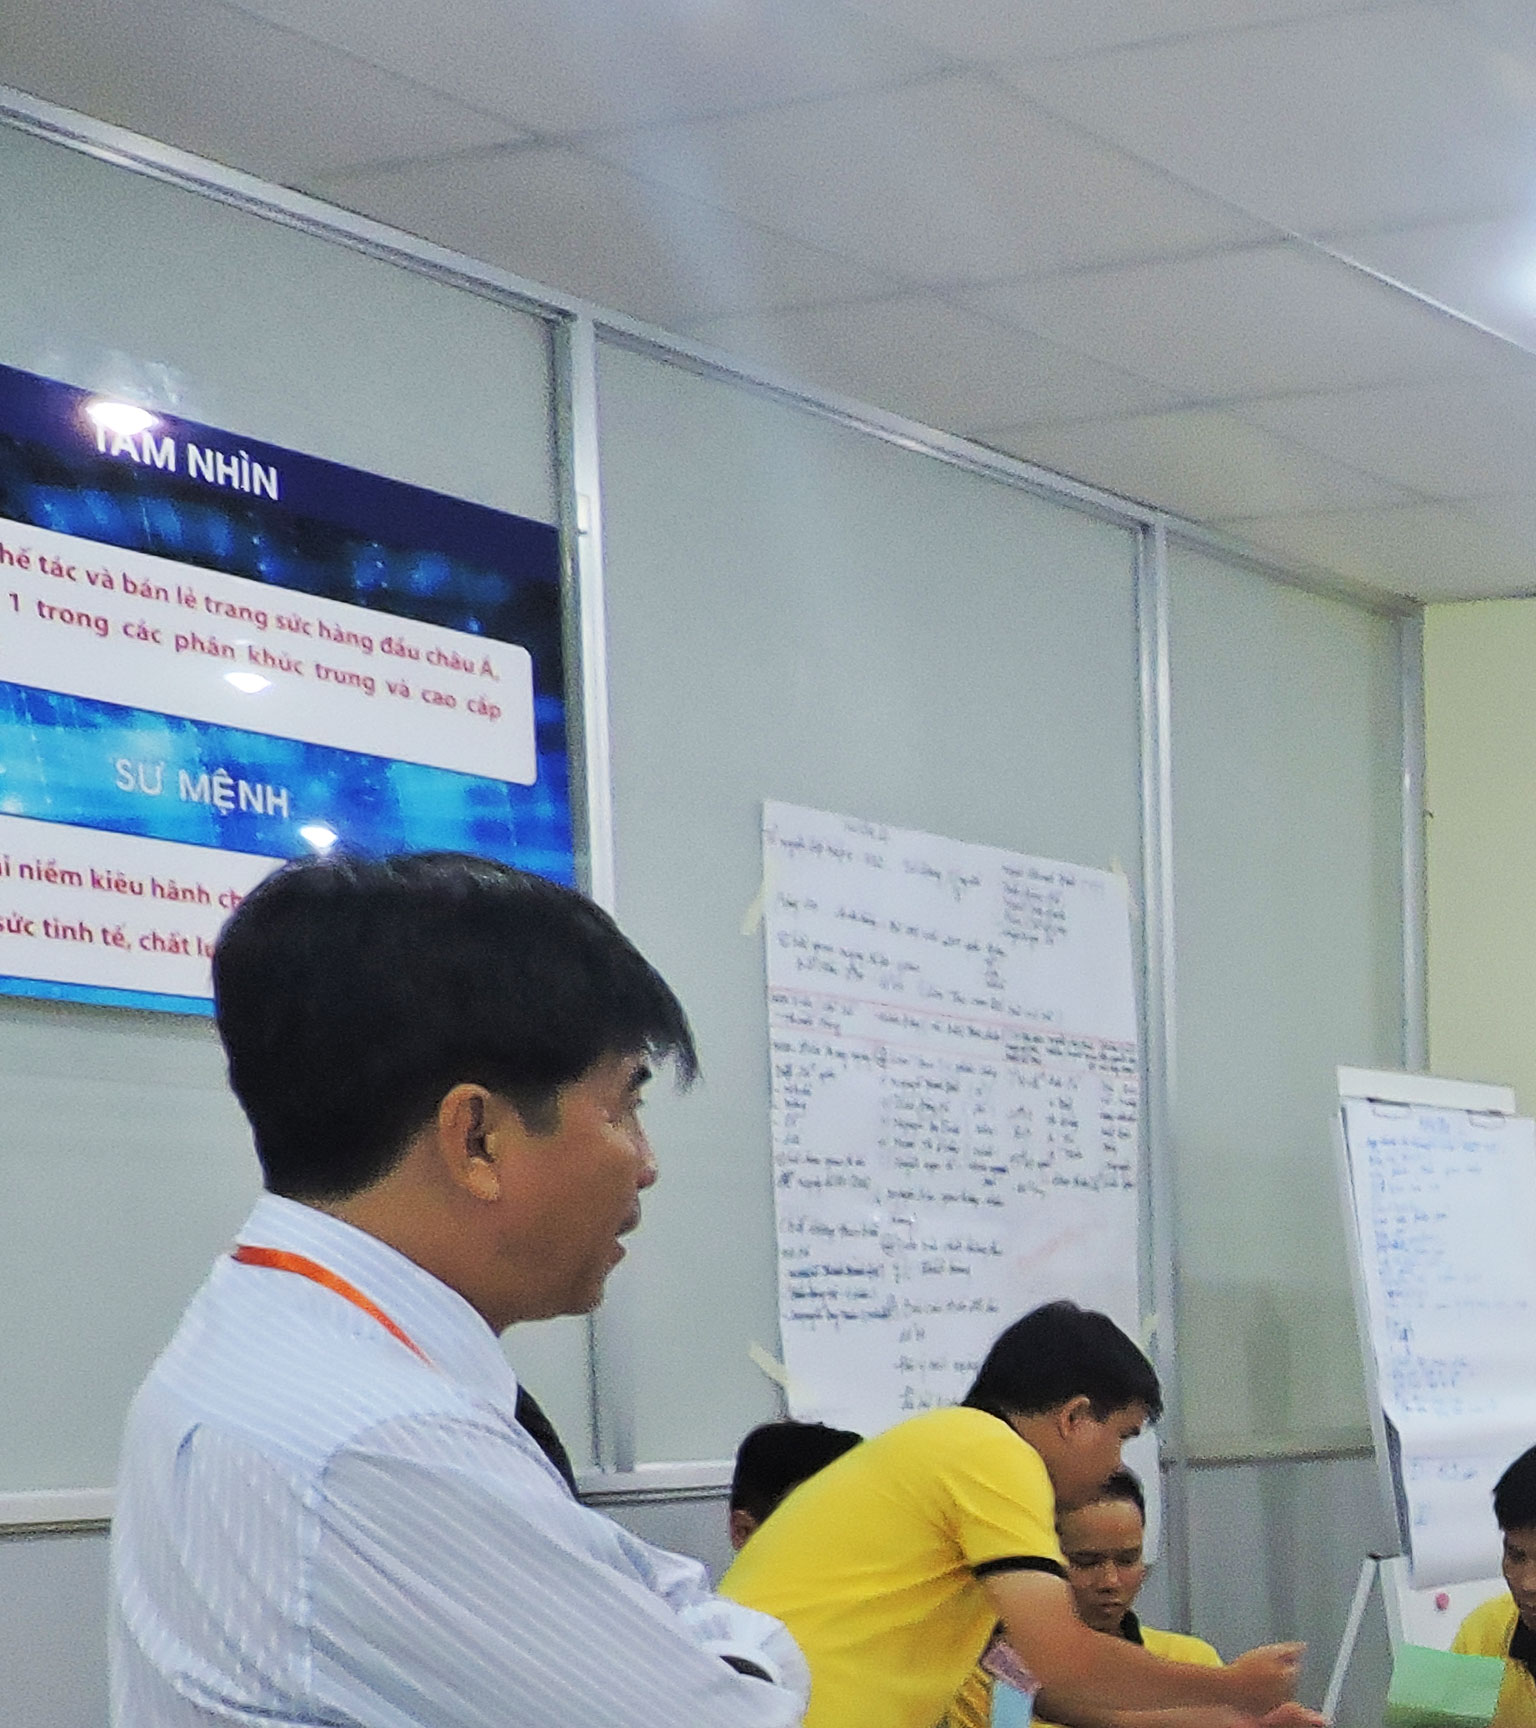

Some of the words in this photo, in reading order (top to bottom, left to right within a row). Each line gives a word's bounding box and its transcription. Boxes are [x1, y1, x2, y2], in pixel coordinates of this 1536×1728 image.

[187, 443, 279, 500] NHÌN
[86, 567, 114, 590] và
[123, 572, 169, 604] bán
[205, 596, 268, 630] trang
[318, 620, 373, 654] hàng
[37, 599, 109, 637] trong
[123, 618, 162, 645] các
[315, 663, 375, 697] trung
[386, 678, 410, 698] và
[422, 688, 457, 709] cao
[179, 767, 289, 818] MỆNH
